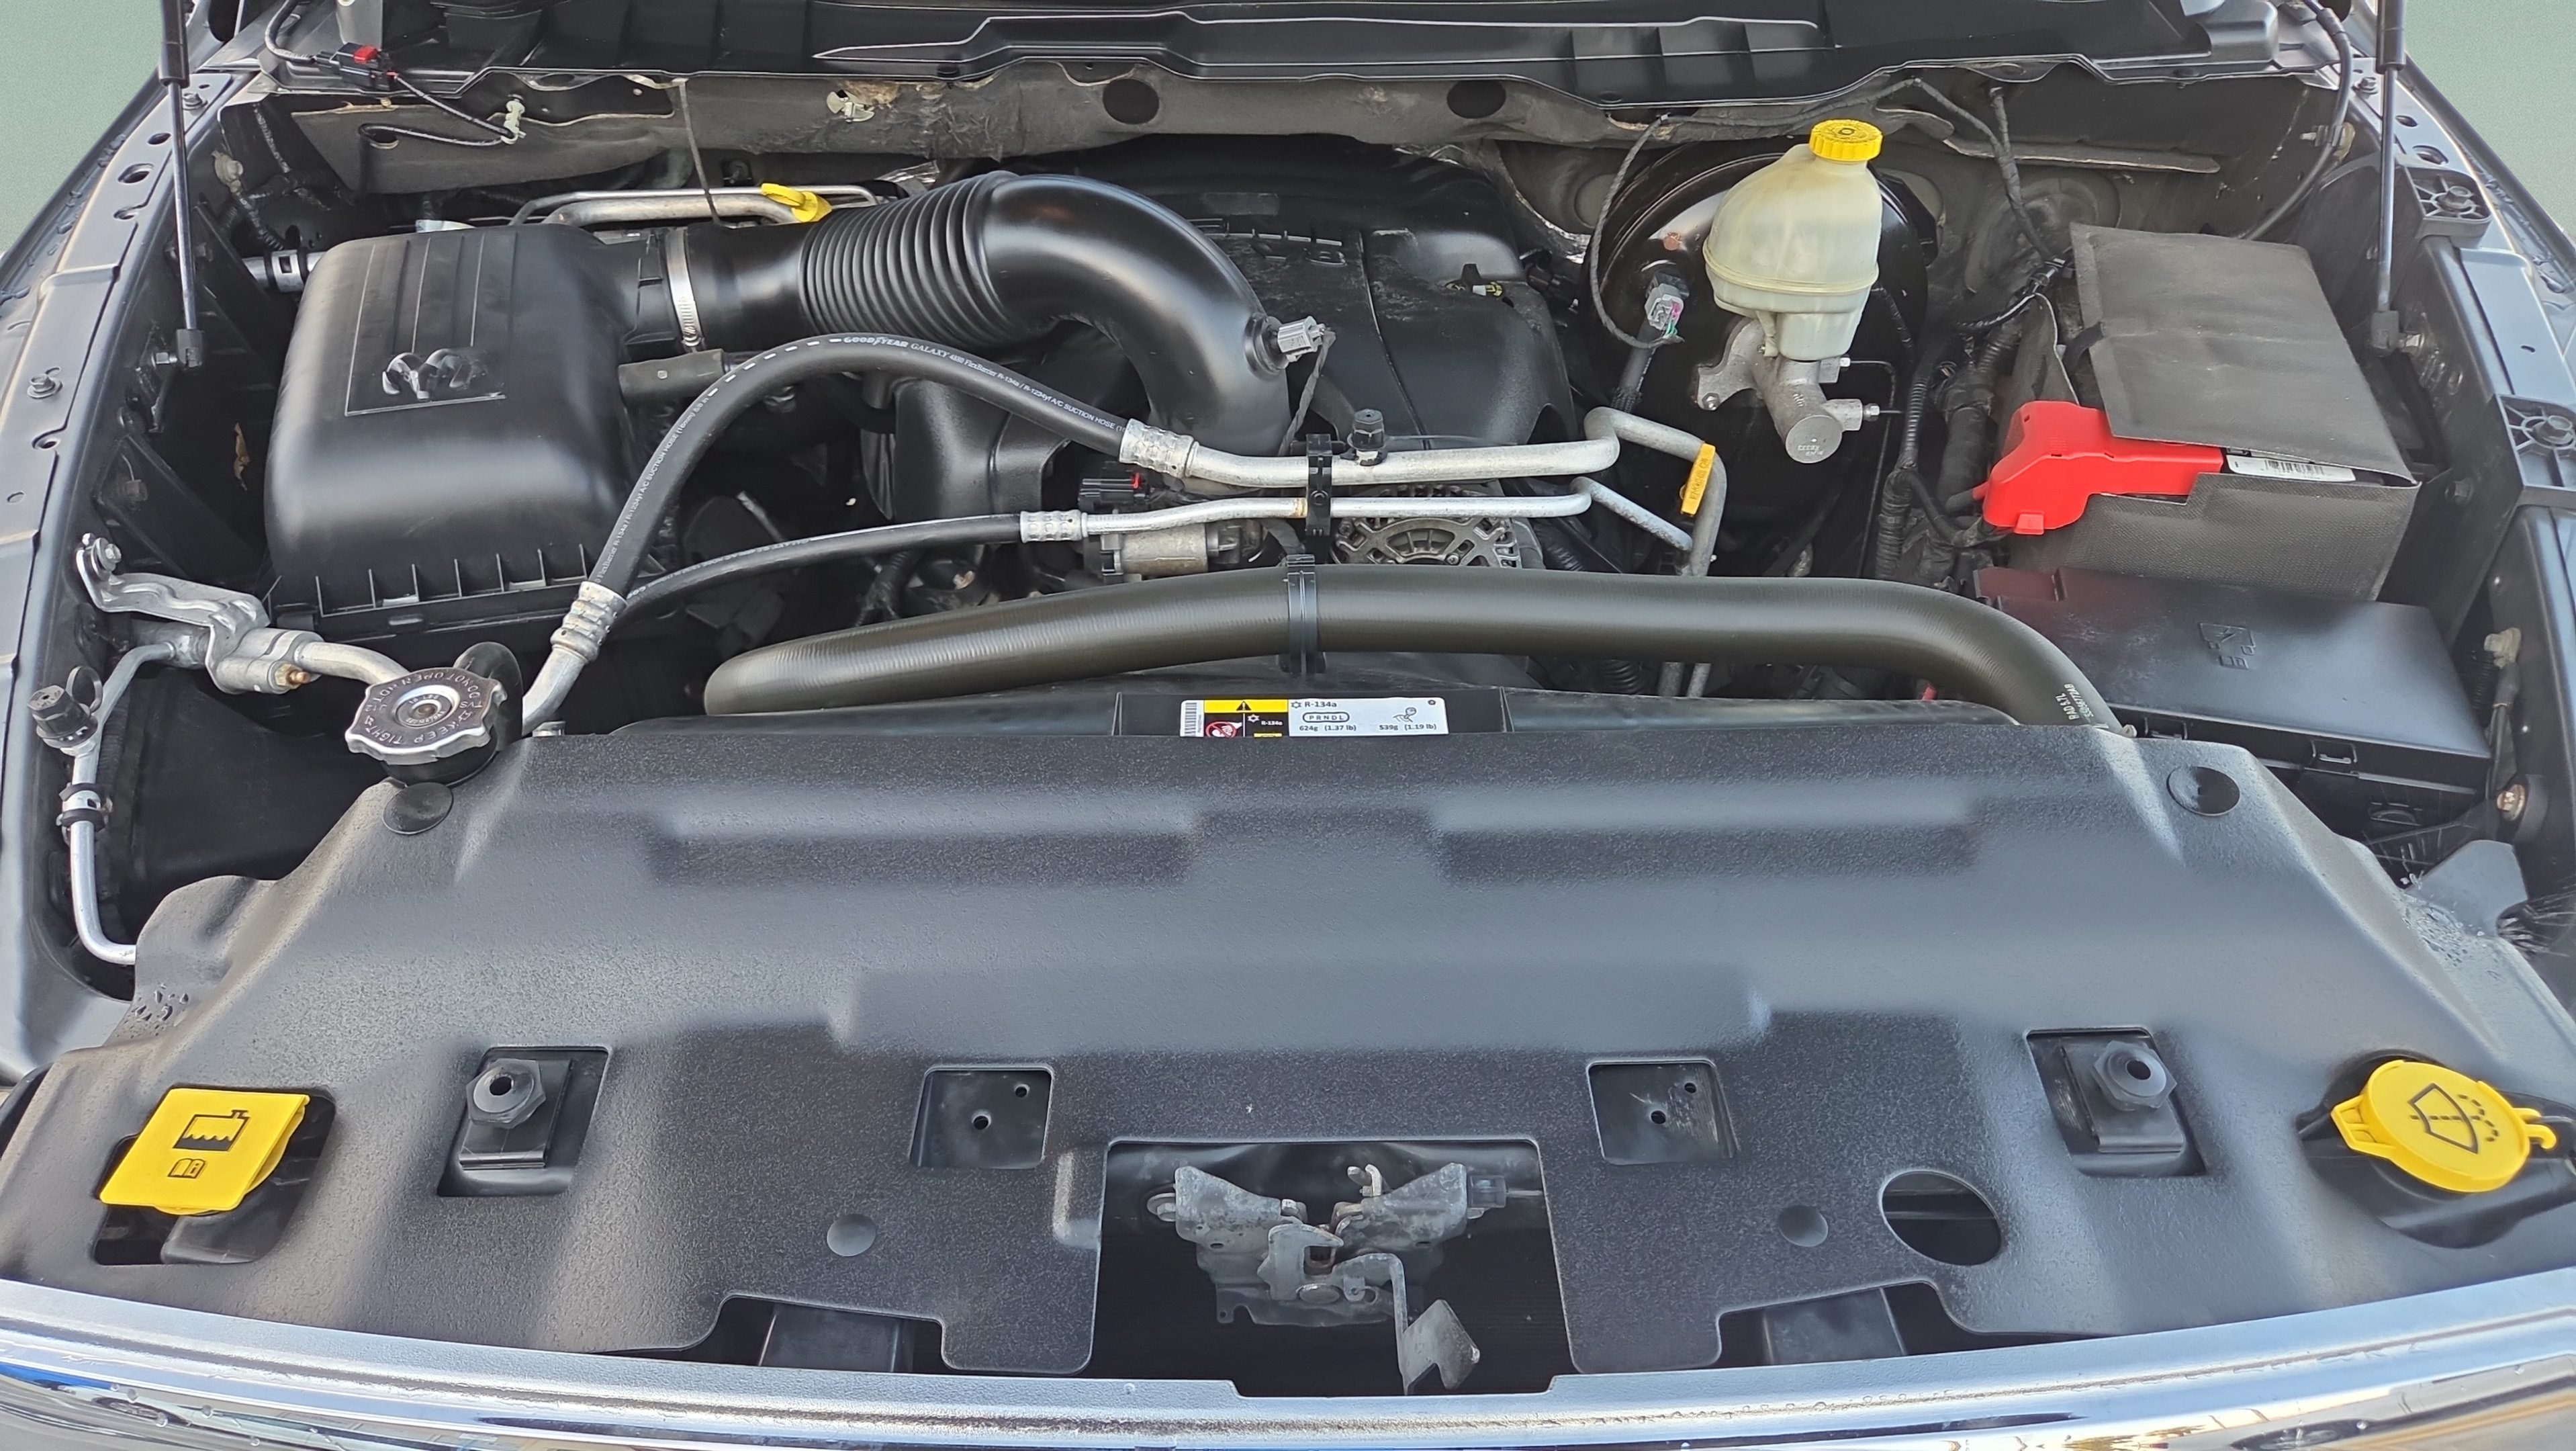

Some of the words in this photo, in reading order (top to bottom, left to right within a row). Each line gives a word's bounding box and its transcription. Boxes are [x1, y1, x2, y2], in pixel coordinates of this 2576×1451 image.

[843, 337, 909, 347] GOODYEAR
[911, 343, 950, 358] GALAXY
[997, 373, 1020, 388] R-134a
[1051, 398, 1064, 407] A/C
[1064, 403, 1095, 421] SUCTION
[1094, 416, 1116, 429] HOSE
[645, 451, 667, 481] SUCTION
[663, 433, 679, 452] HOSE
[402, 672, 445, 685] OPEN
[373, 683, 399, 703] HOT
[2063, 705, 2080, 720] RAD
[365, 726, 404, 745] TIGHT
[414, 721, 460, 744] KEEP
[1426, 723, 1437, 731] lb)
